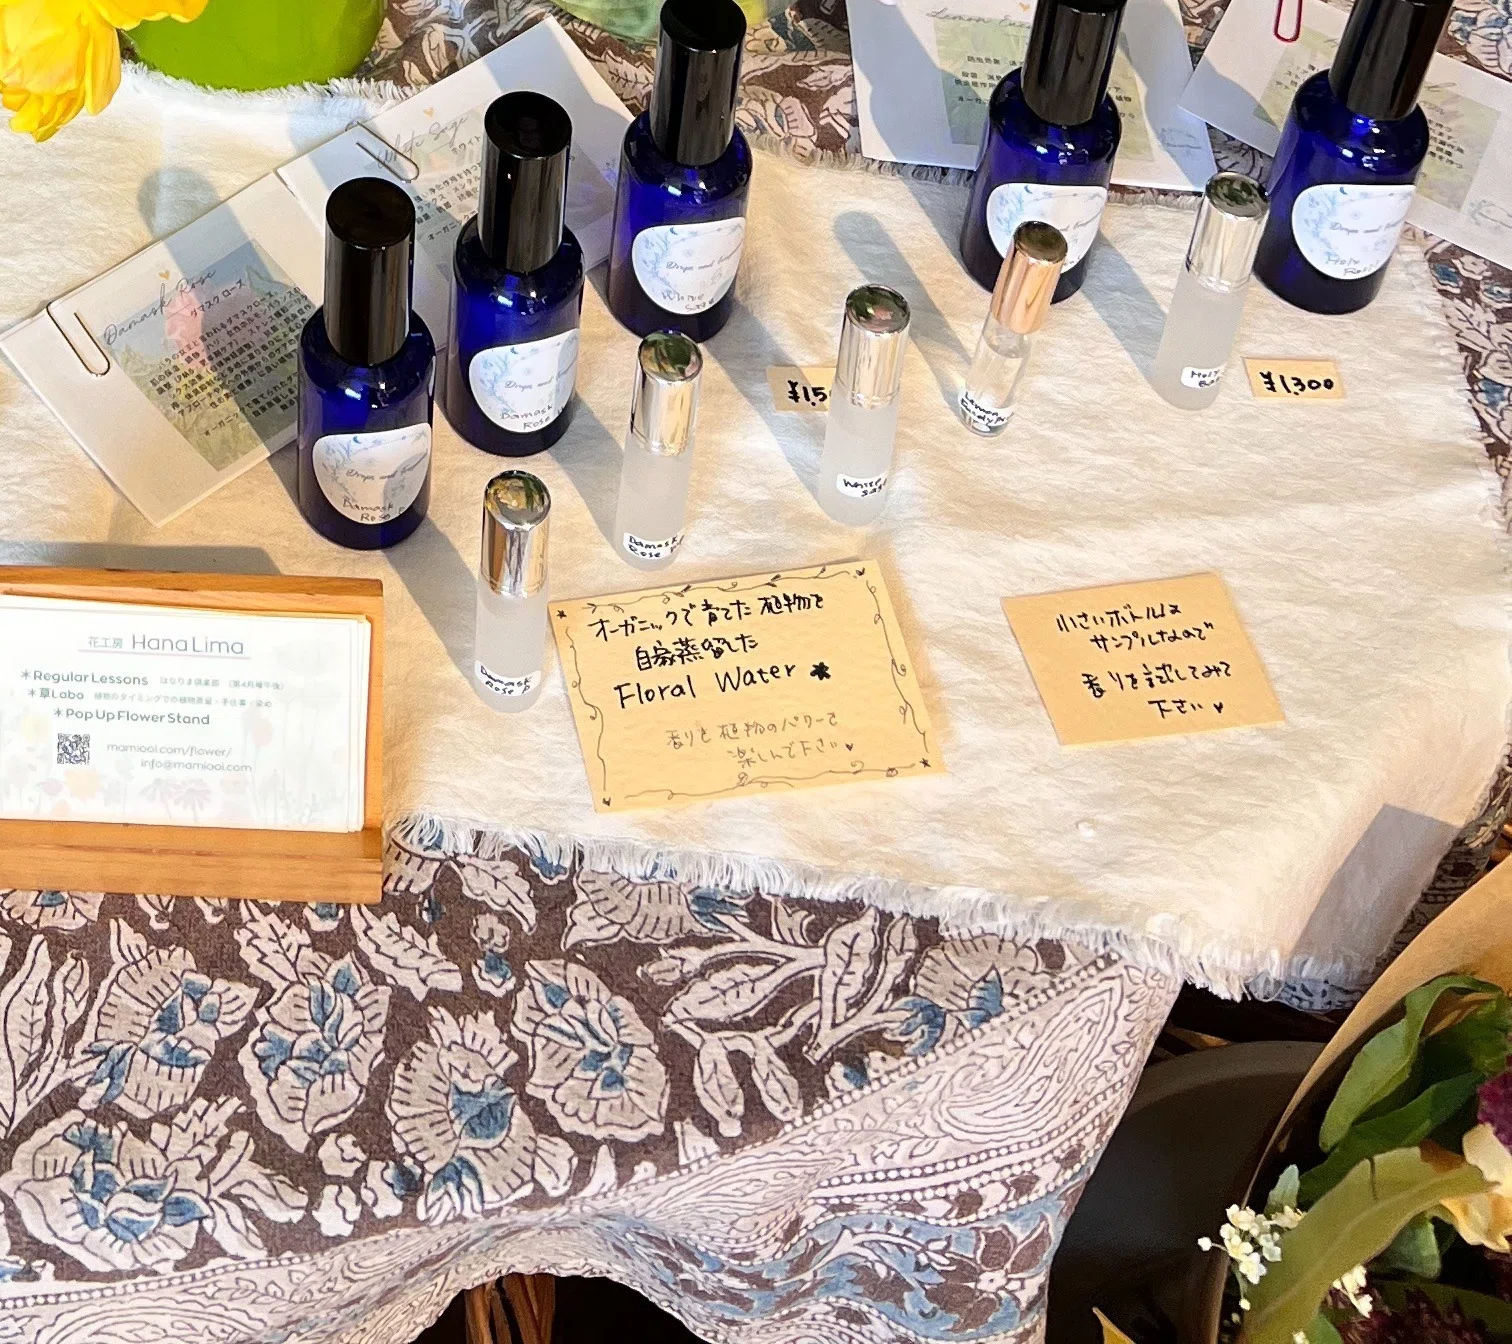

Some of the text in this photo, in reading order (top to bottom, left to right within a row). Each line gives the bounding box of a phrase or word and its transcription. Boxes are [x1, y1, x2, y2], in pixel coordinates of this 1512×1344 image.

[1056, 603, 1183, 633] 小さいボトルは
[132, 634, 189, 653] Hana
[192, 635, 245, 655] Lima
[1090, 621, 1215, 654] サンプルなので
[33, 669, 89, 687] Regular
[90, 671, 150, 687] Lessons
[612, 664, 797, 710] Floral Water
[1081, 660, 1232, 699] 香りを試してみて
[65, 708, 211, 726] Pop Up Flower Stand
[1147, 698, 1205, 719] 下さい
